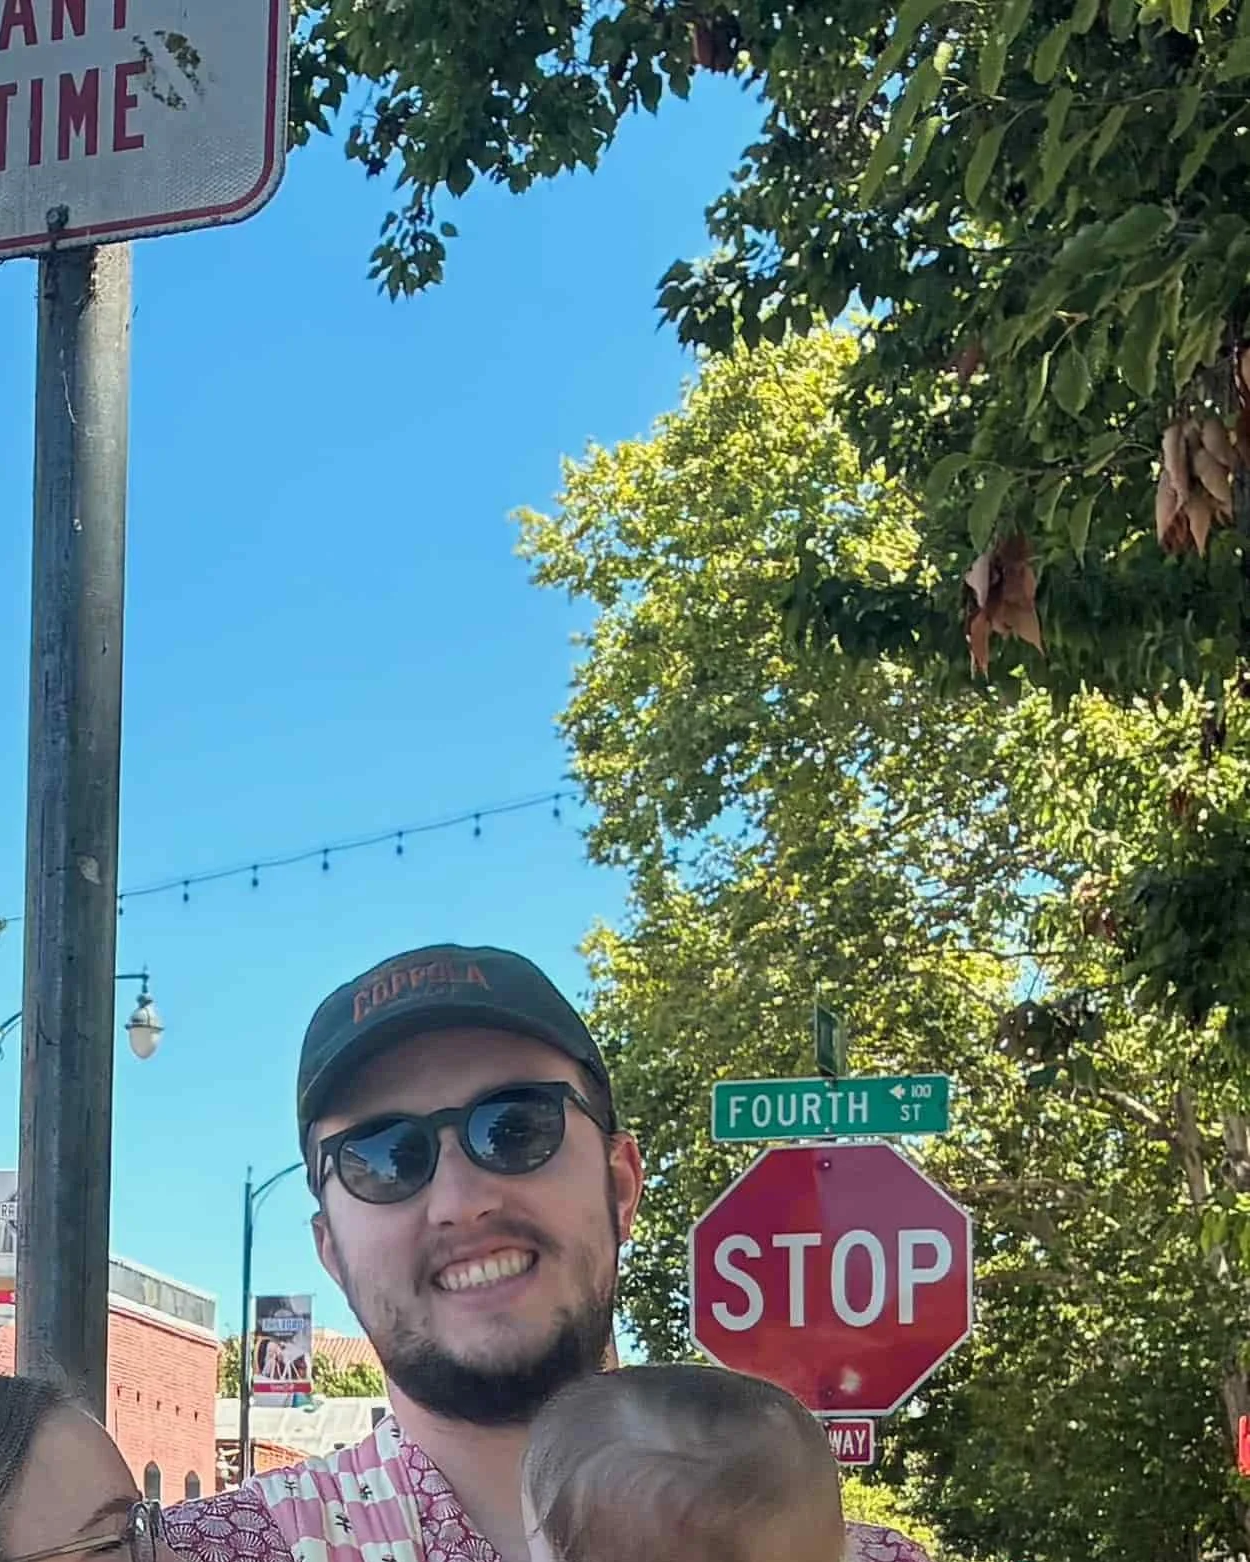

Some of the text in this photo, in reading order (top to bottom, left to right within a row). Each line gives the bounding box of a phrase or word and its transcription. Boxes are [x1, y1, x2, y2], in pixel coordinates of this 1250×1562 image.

[729, 1092, 868, 1128] FOURTH
[900, 1104, 922, 1121] ST
[712, 1229, 952, 1332] STOP
[828, 1429, 866, 1455] WAY
